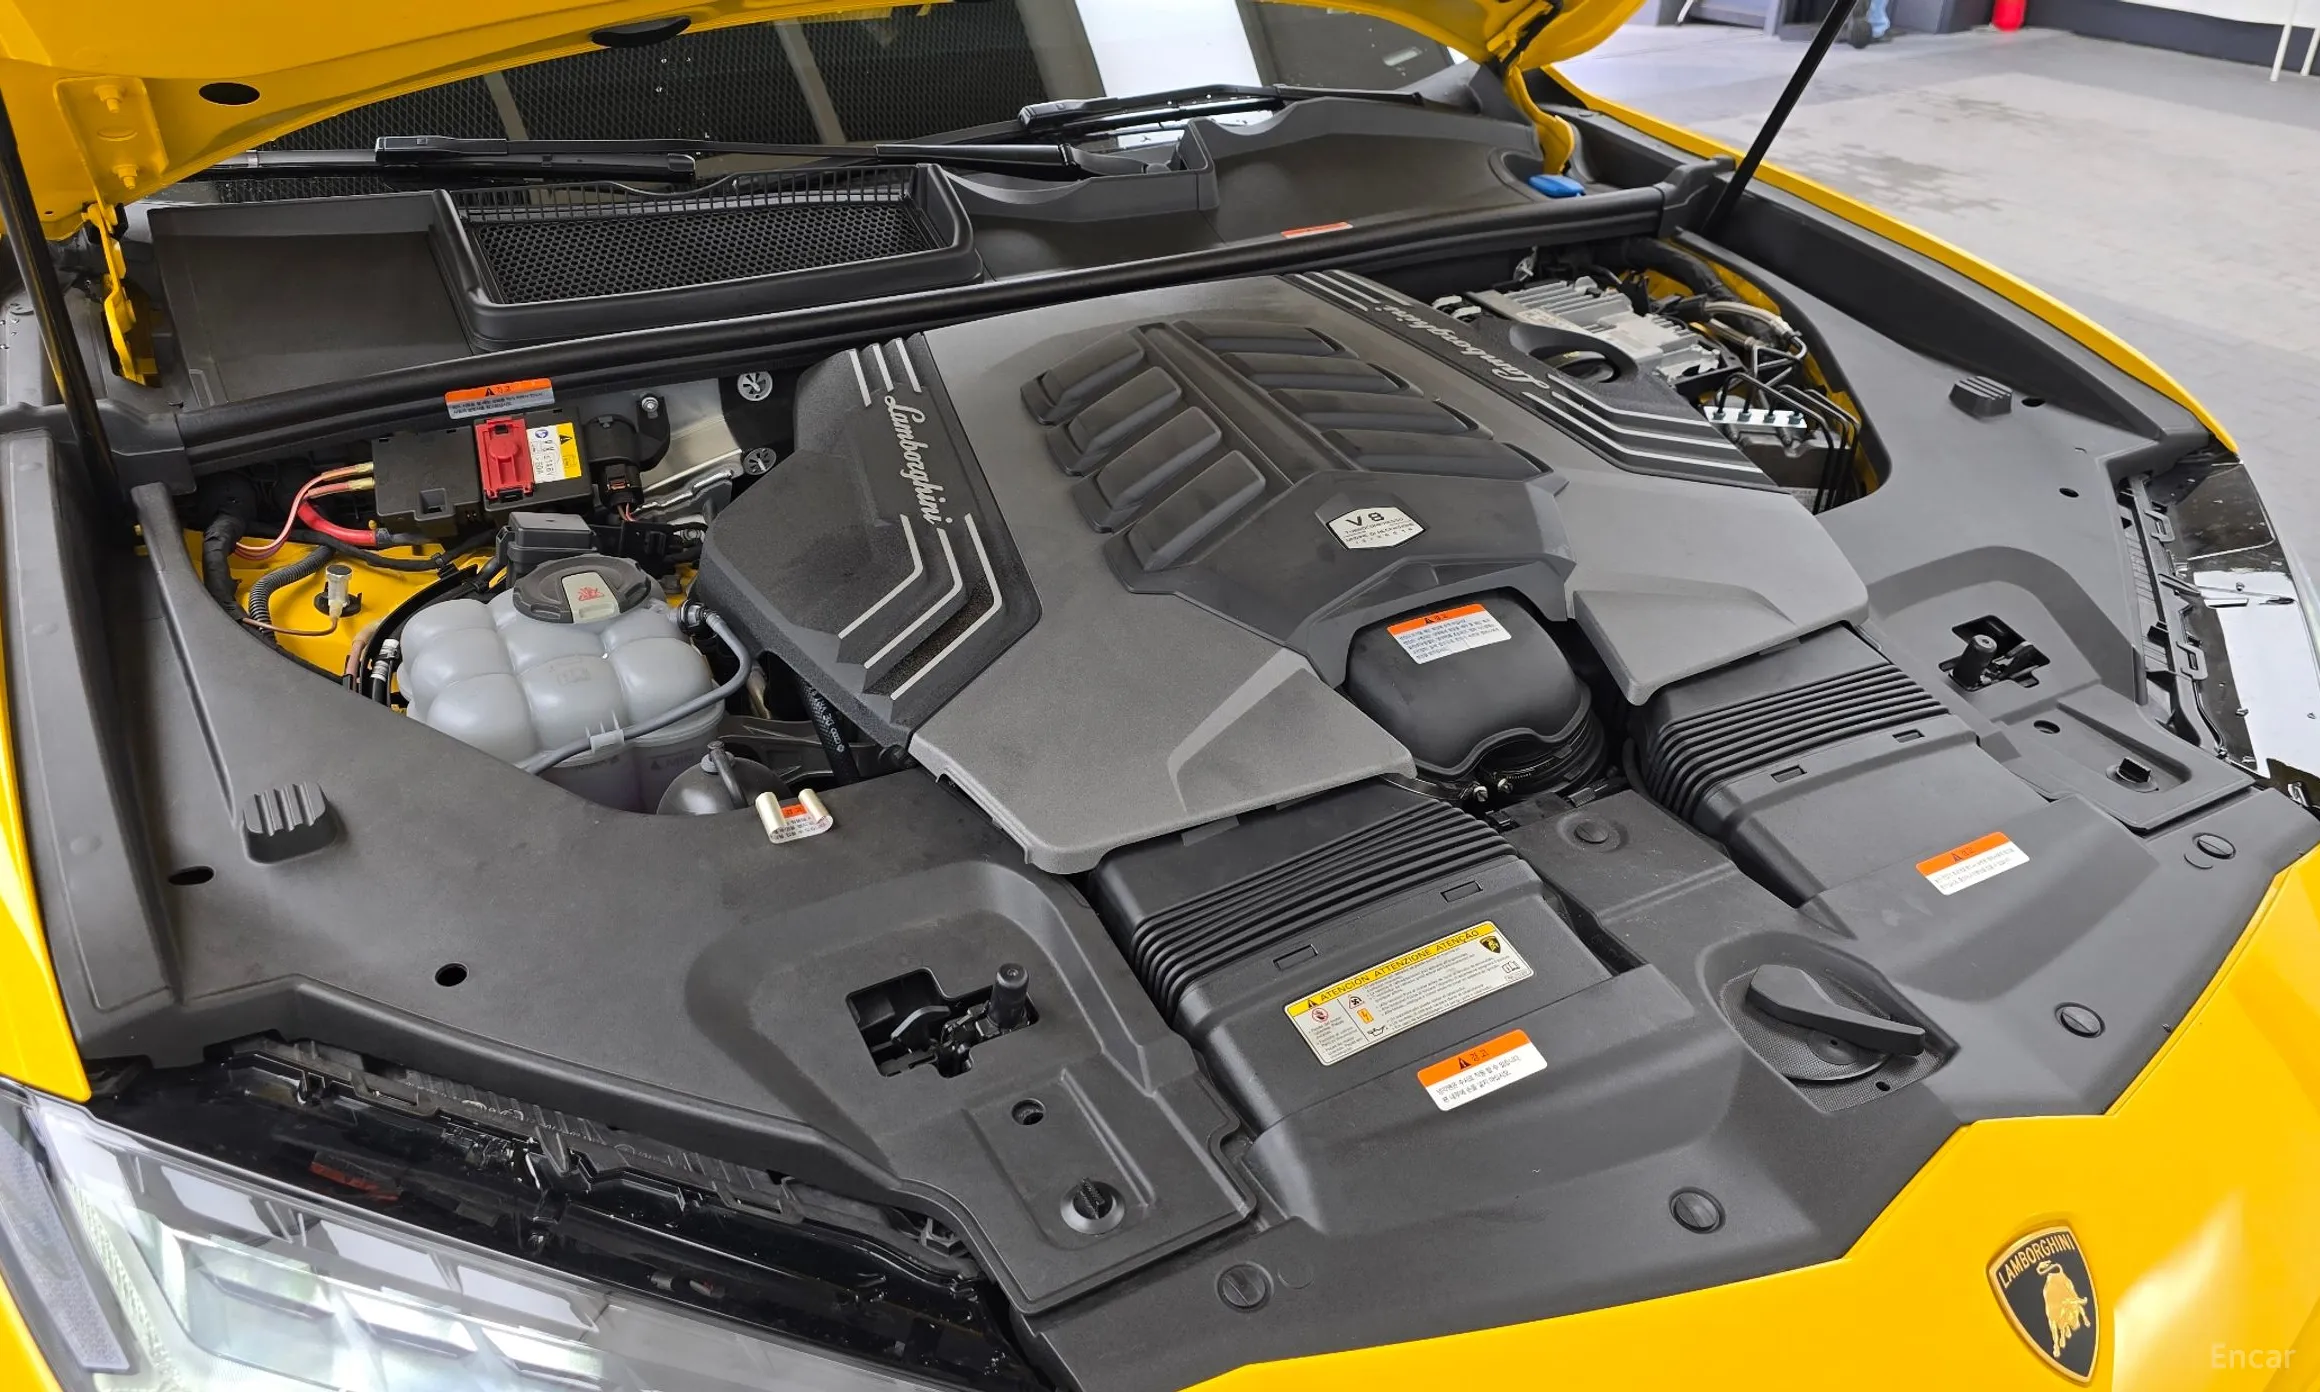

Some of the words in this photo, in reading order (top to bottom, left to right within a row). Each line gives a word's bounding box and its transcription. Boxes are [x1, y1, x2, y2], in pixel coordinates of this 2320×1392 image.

[1375, 304, 1550, 389] Lamborghini
[884, 395, 953, 525] Lamborghini
[1374, 949, 1431, 977] ATTENZIONE
[1470, 1049, 1489, 1062] 경고
[1999, 1234, 2076, 1289] LAMBORGHINI
